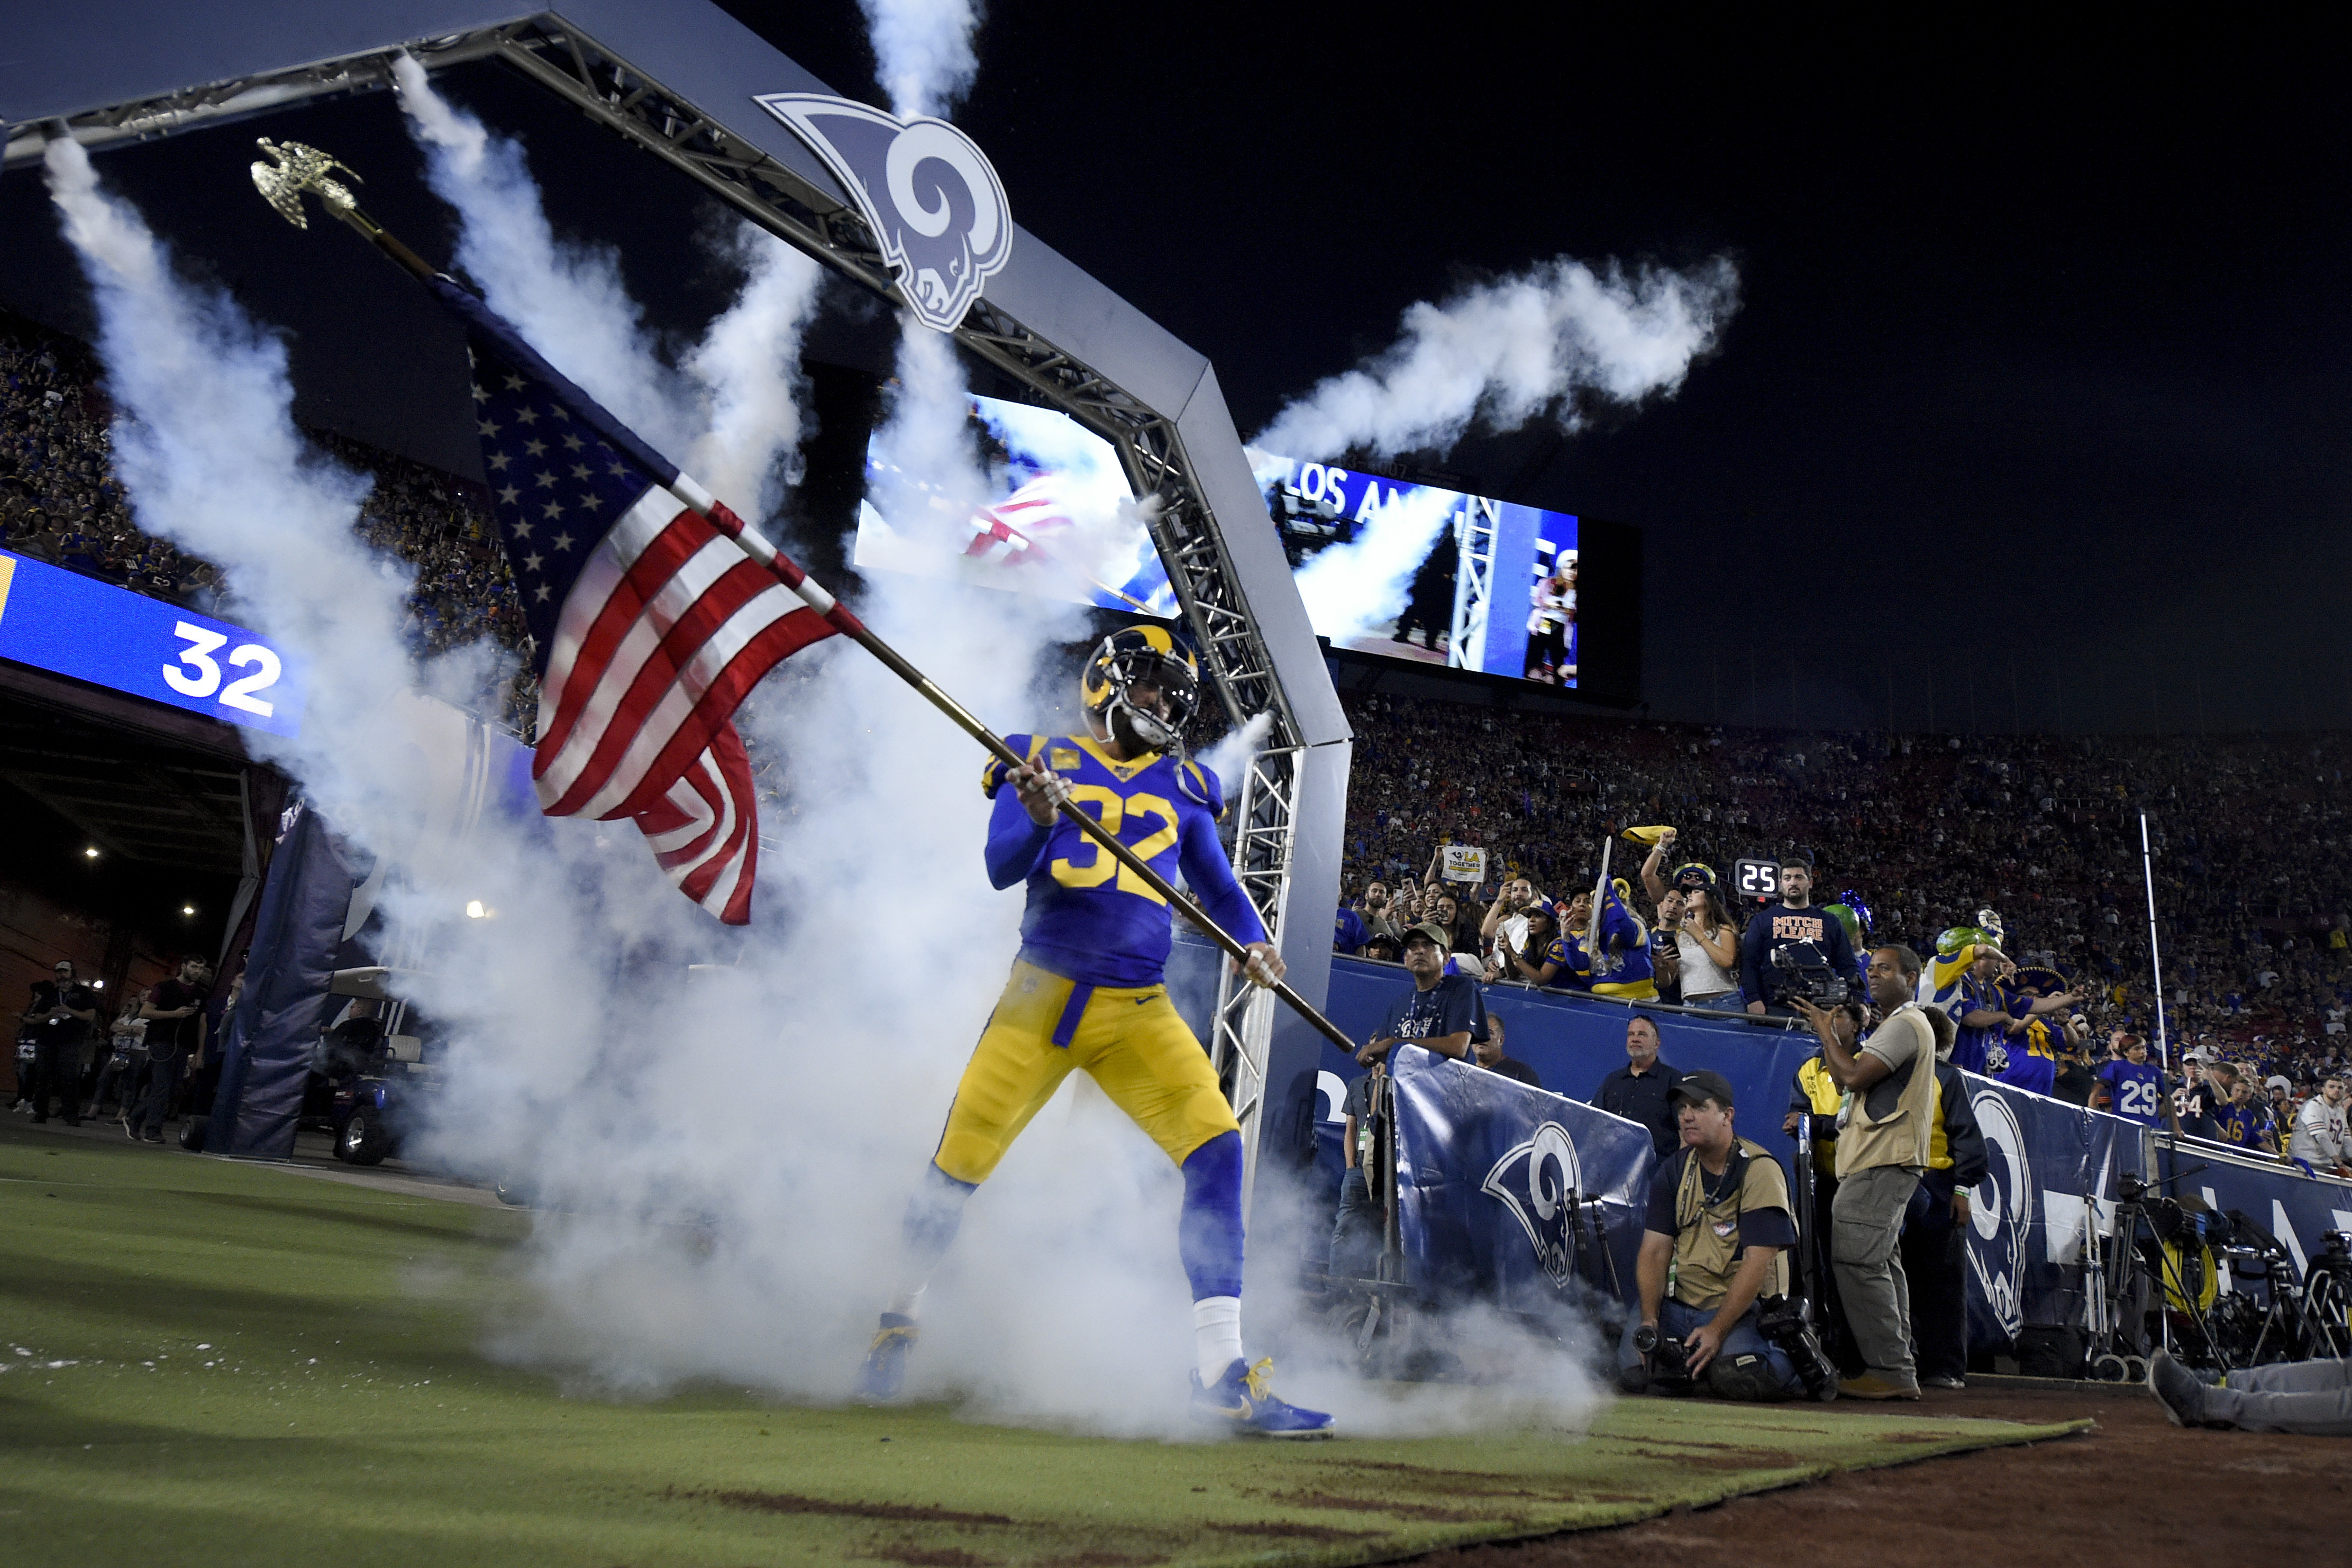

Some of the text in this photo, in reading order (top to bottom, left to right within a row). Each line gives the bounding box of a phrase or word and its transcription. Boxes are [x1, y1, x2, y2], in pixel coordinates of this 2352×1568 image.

[1284, 459, 1348, 514] LOS
[162, 621, 281, 717] 32
[1051, 785, 1180, 906] 32
[1464, 851, 1480, 862] LA
[1449, 860, 1480, 868] TOGETHER
[1743, 864, 1775, 892] 25
[1773, 916, 1823, 928] MITCH
[1773, 926, 1824, 941] PLEASE
[2027, 1019, 2055, 1062] 16
[2121, 1080, 2157, 1117] 29
[2227, 1118, 2245, 1142] 16
[2329, 1118, 2343, 1145] 52
